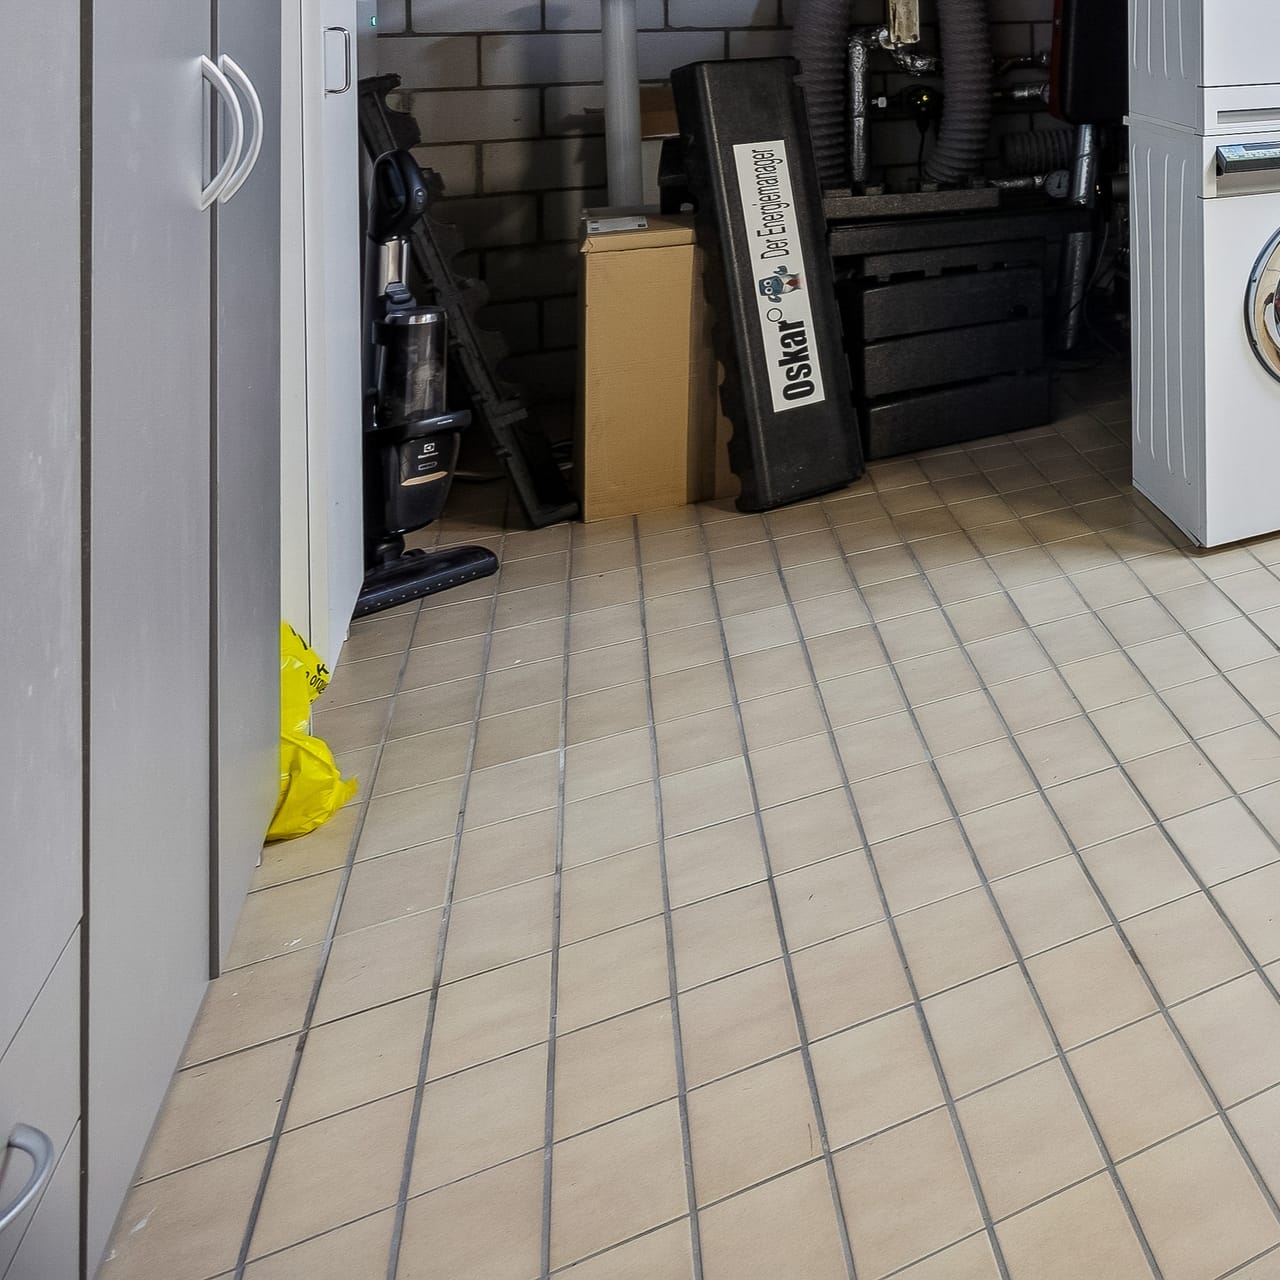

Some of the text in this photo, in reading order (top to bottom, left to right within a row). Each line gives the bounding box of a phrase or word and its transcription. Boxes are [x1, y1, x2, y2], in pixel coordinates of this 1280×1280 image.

[752, 149, 815, 401] Oskar Der Energiemanager
